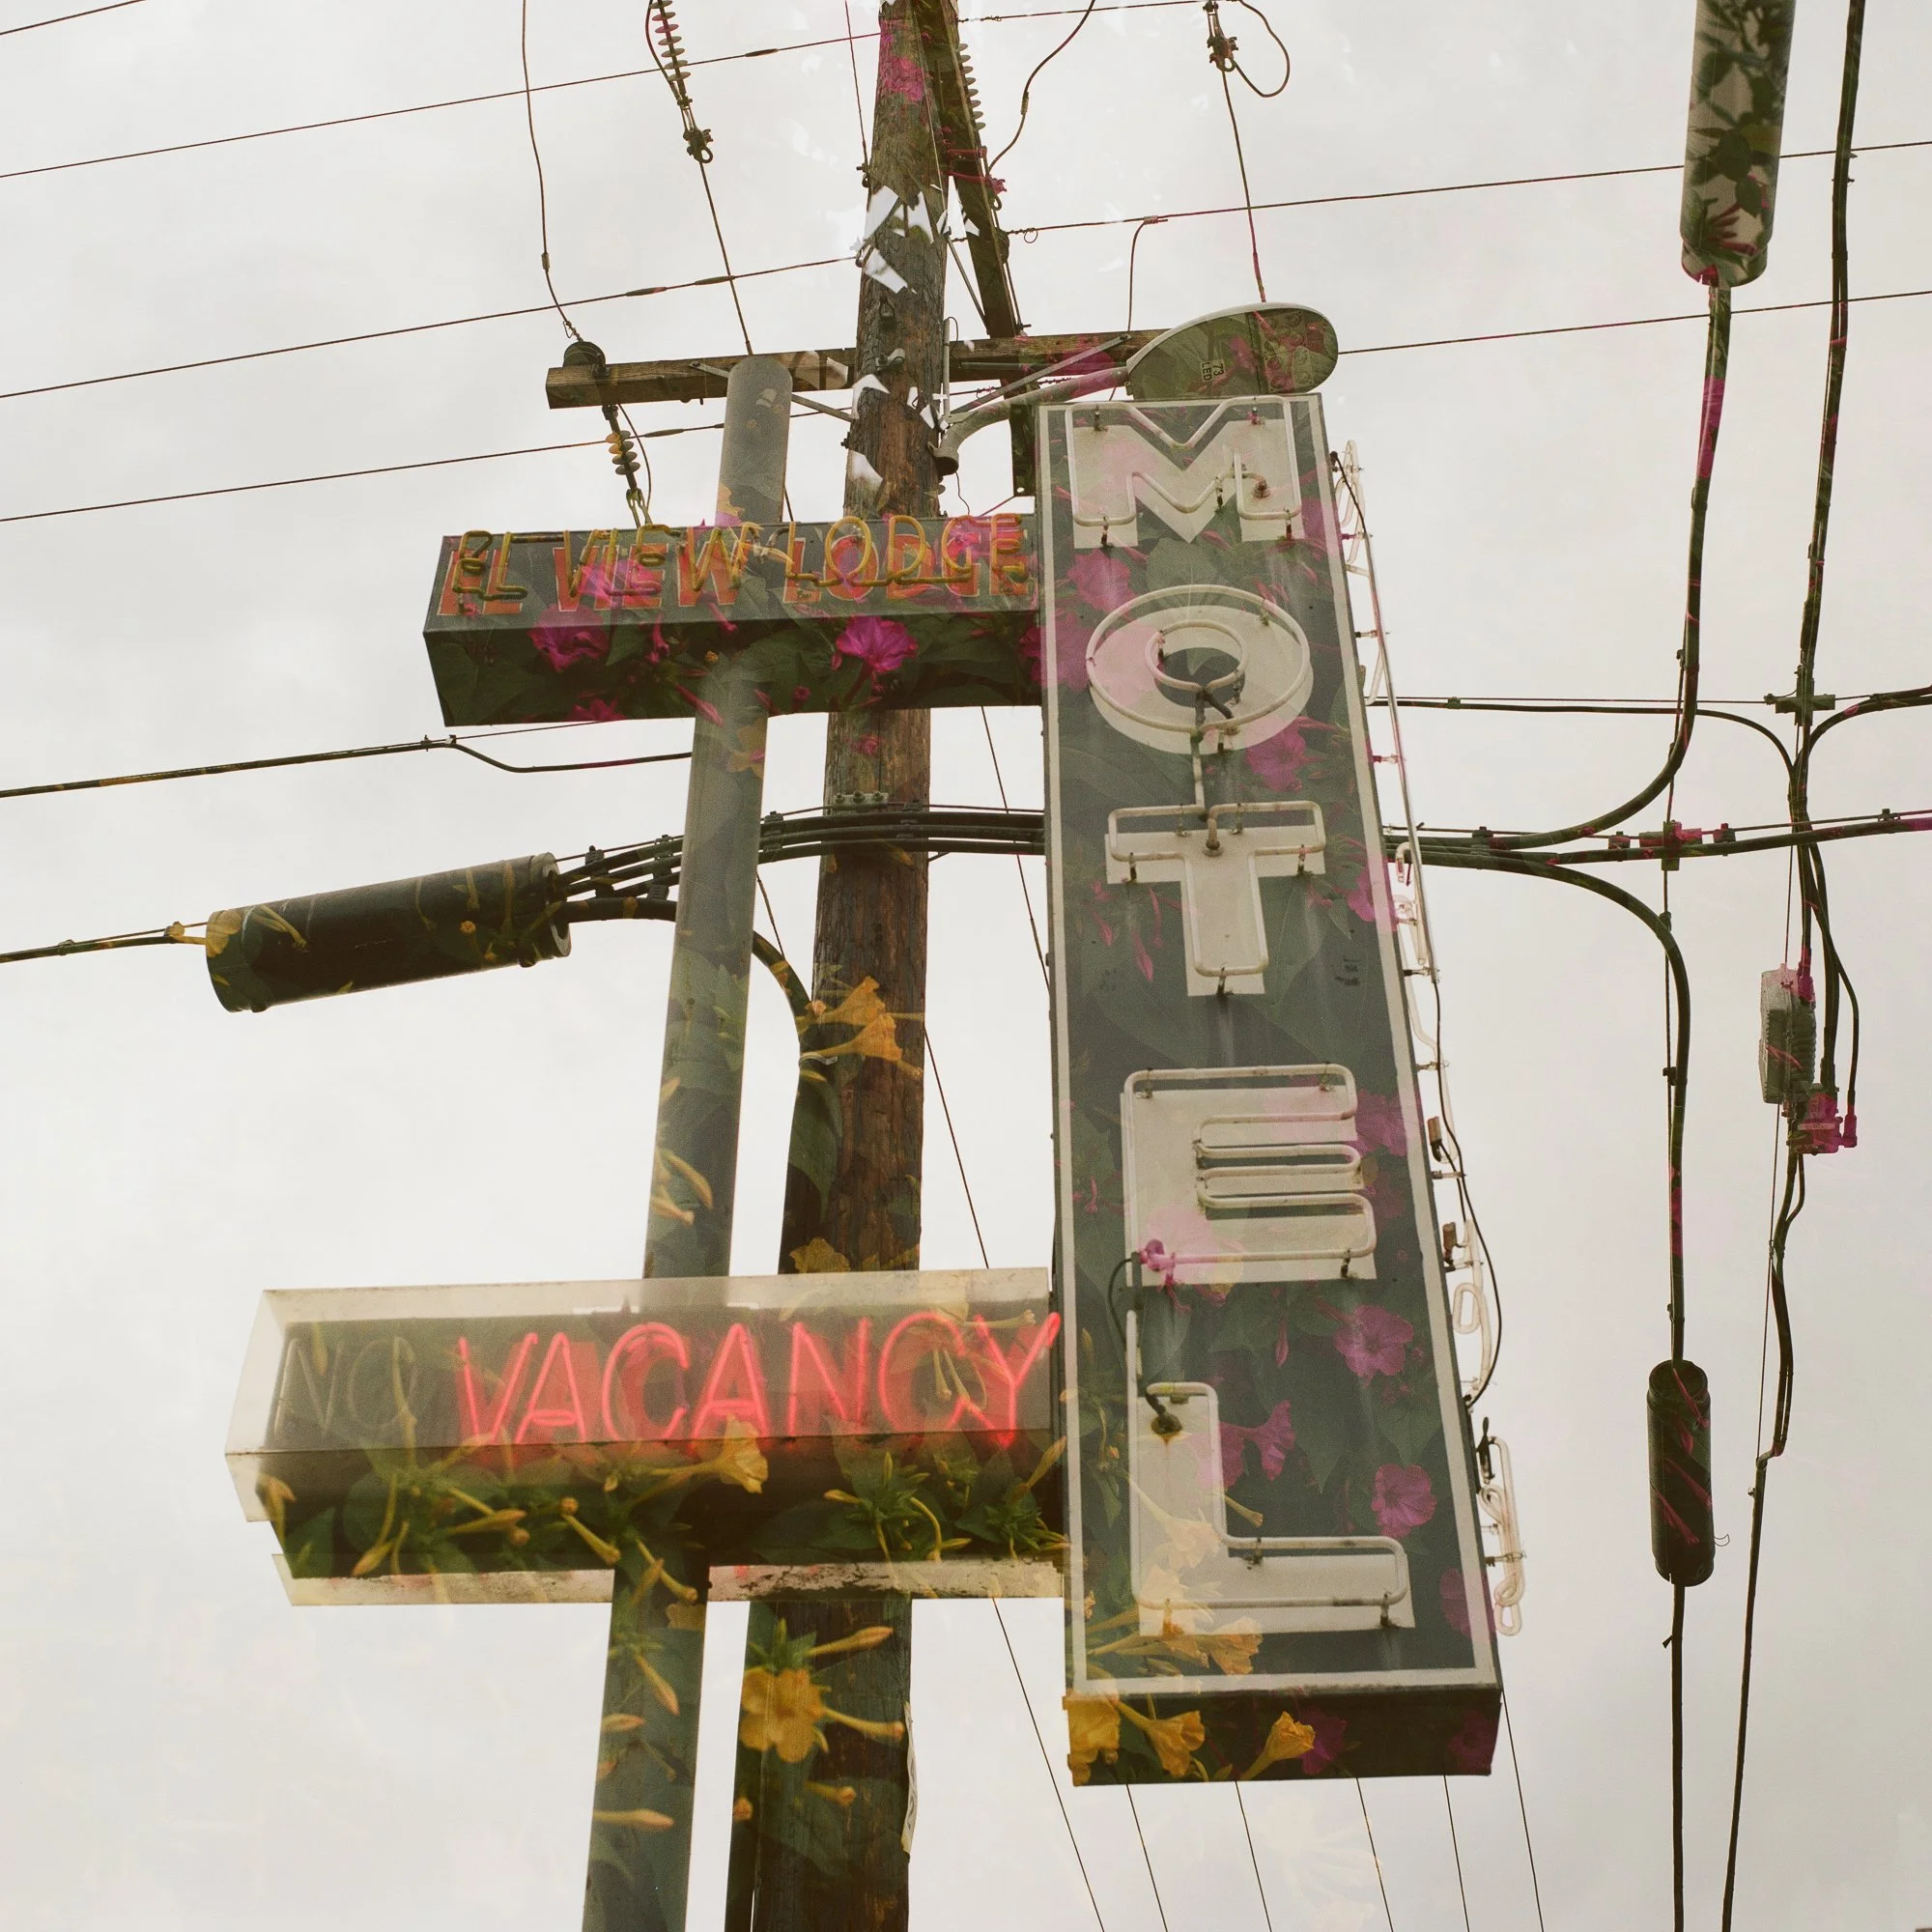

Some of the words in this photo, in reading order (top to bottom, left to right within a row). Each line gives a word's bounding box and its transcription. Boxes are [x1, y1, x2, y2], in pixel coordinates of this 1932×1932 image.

[1203, 362, 1212, 381] LED
[1213, 363, 1224, 376] 73
[437, 529, 527, 616] EL
[552, 524, 759, 612] VIEW
[782, 513, 1031, 604] LODGE
[1065, 396, 1416, 1635] MOTEL
[273, 1337, 418, 1439] NO
[456, 1312, 1061, 1449] VACANCY
